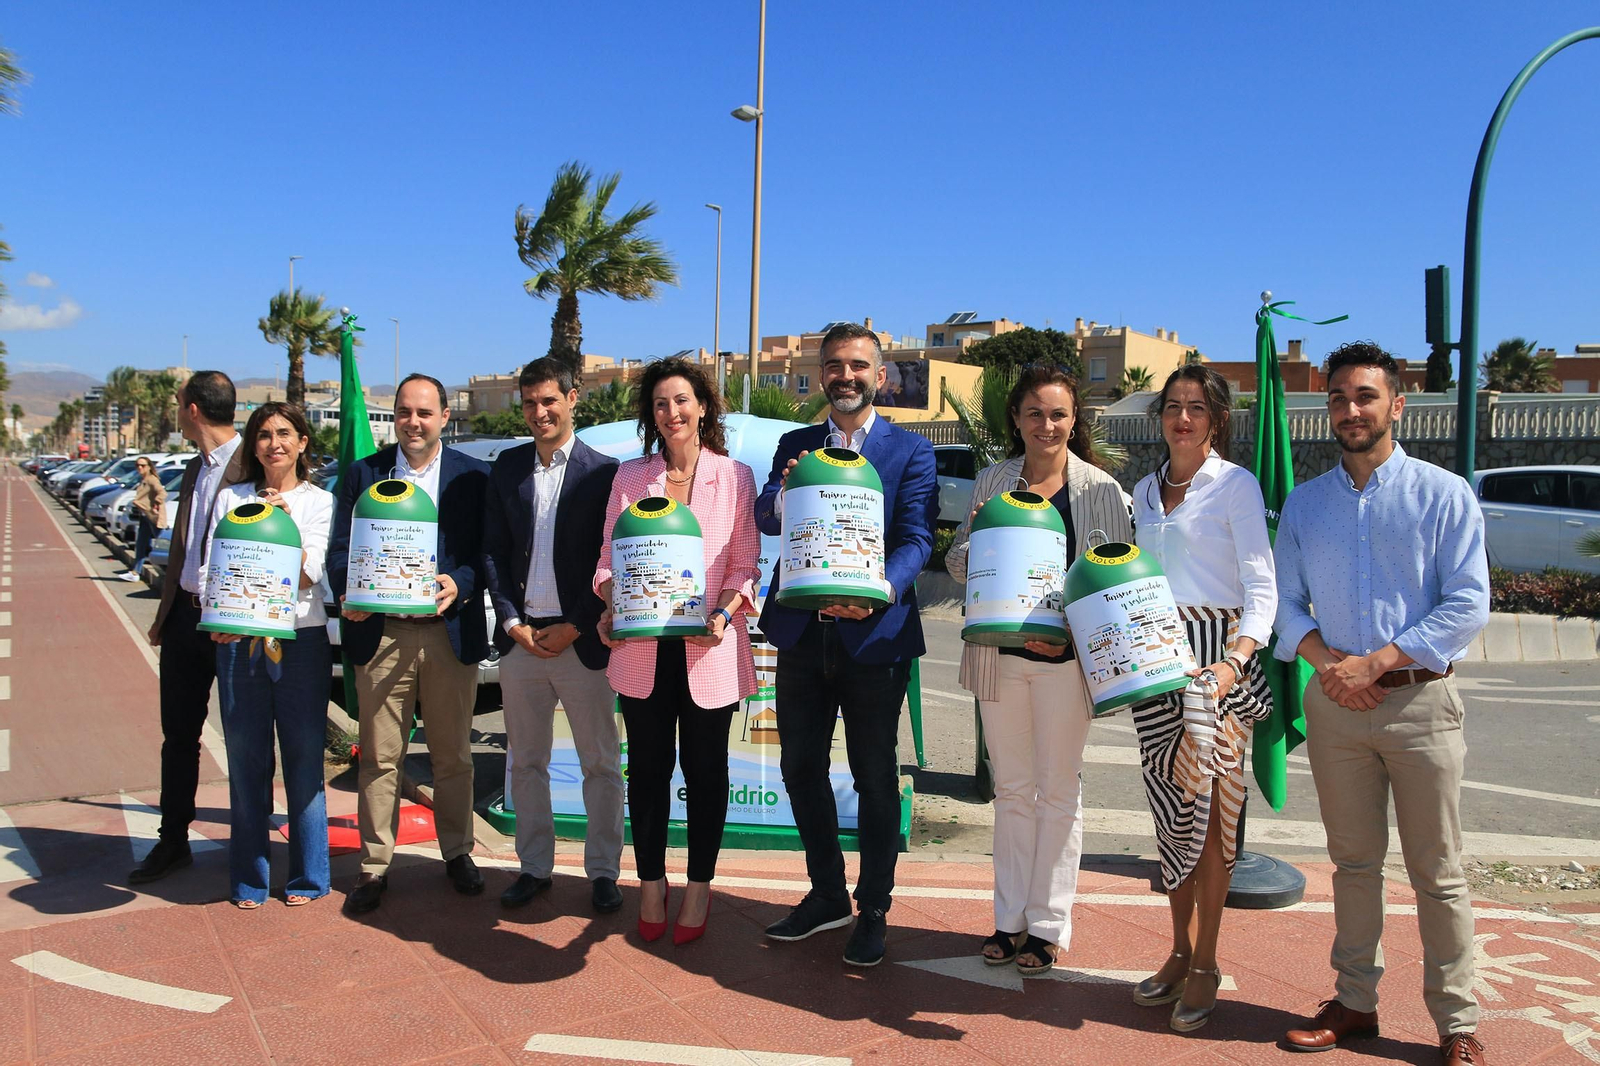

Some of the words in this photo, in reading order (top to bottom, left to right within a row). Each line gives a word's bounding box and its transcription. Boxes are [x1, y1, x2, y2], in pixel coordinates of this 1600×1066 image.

[832, 569, 871, 580] ecovidrio
[376, 591, 412, 600] ecovidrio
[219, 610, 255, 620] ecovidrio
[624, 612, 659, 622] ecovidrio
[1144, 661, 1183, 678] ecovidrio
